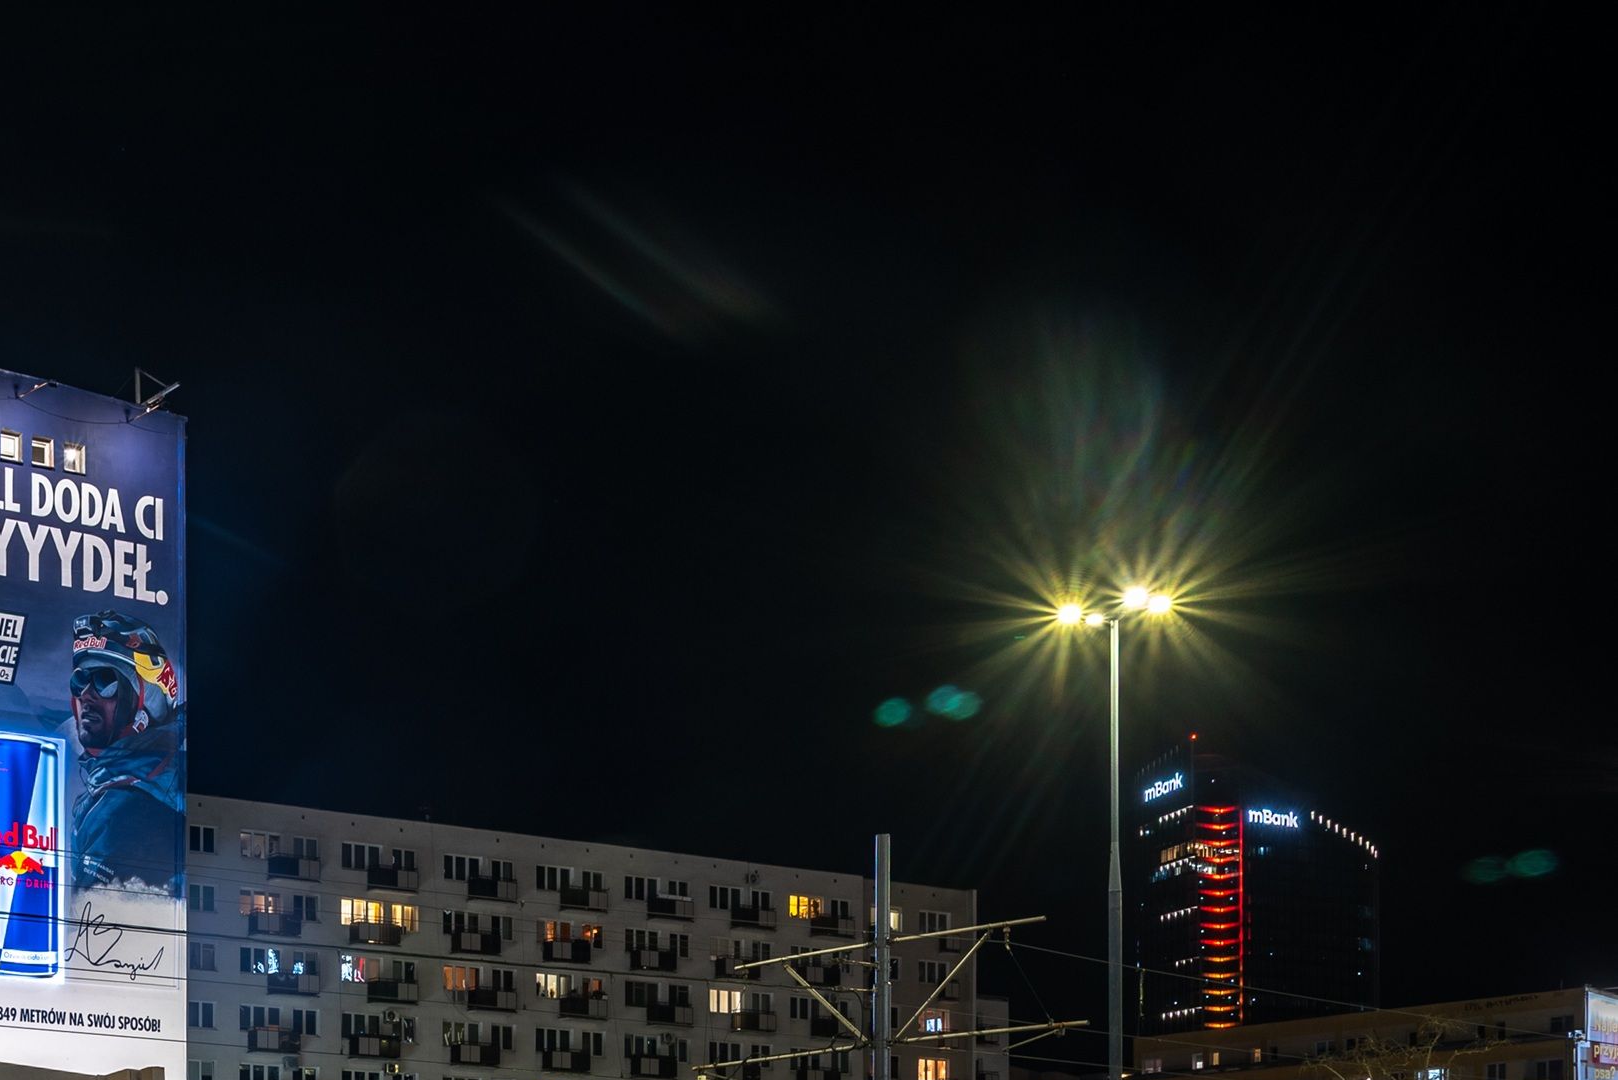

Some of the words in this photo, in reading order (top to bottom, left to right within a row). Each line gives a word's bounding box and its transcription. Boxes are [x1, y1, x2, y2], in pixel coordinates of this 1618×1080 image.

[31, 472, 126, 534] DODA
[134, 495, 164, 541] CI
[90, 637, 106, 648] Bull
[1144, 772, 1183, 802] mBank
[1248, 808, 1298, 828] mBank
[23, 824, 59, 851] Bull
[20, 1005, 67, 1025] METRÓW
[69, 1013, 85, 1027] NA
[87, 1011, 116, 1030] SWÓJ
[118, 1014, 161, 1033] SPOSÓB!
[1594, 1066, 1616, 1080] psa?
